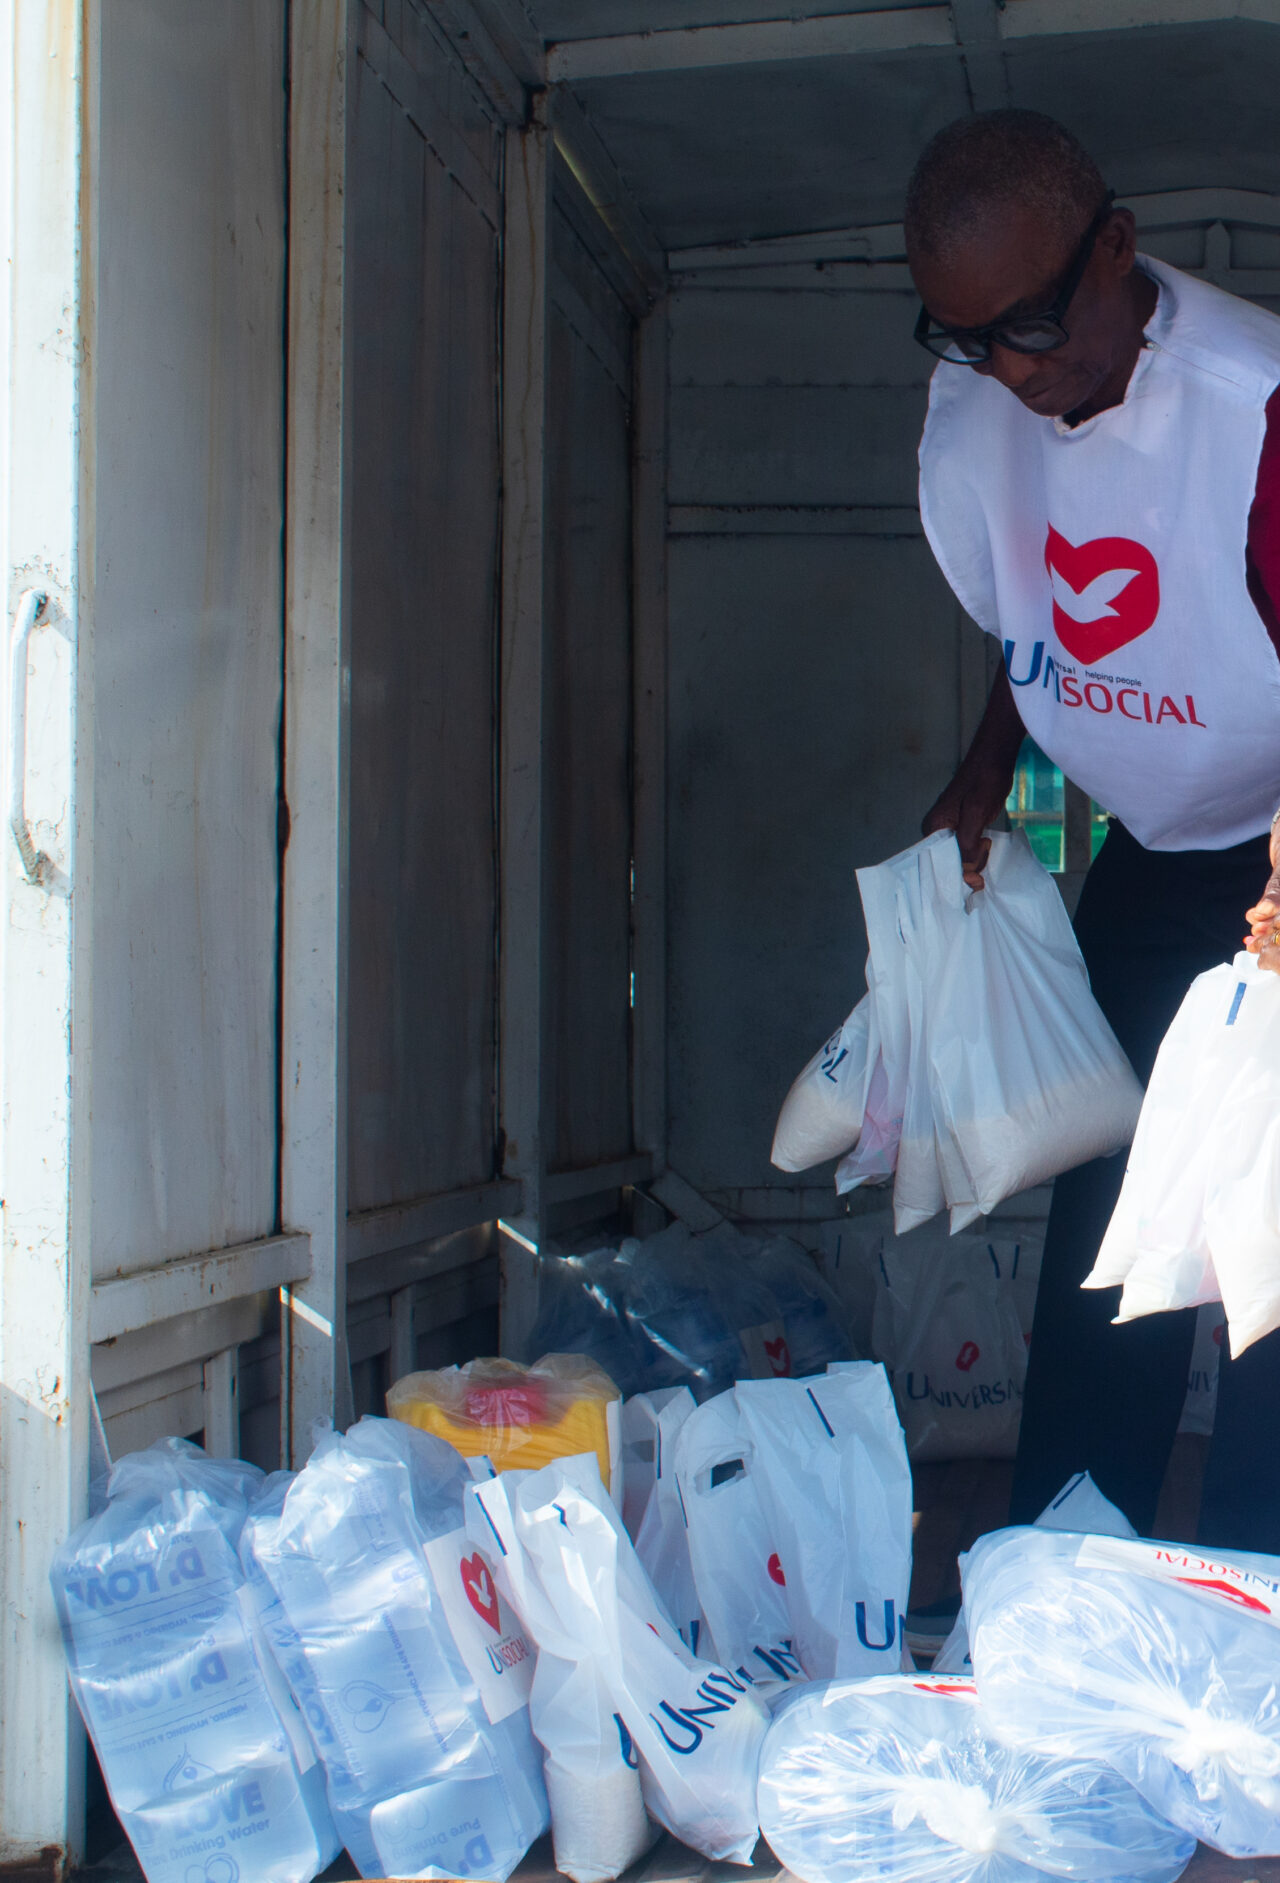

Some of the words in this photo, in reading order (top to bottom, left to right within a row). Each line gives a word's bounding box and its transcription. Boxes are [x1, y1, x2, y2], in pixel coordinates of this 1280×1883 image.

[1085, 669, 1114, 683] helping
[1116, 676, 1142, 688] people
[450, 1817, 482, 1836] Pure
[169, 1834, 226, 1861] Drinking
[227, 1818, 271, 1842] Water
